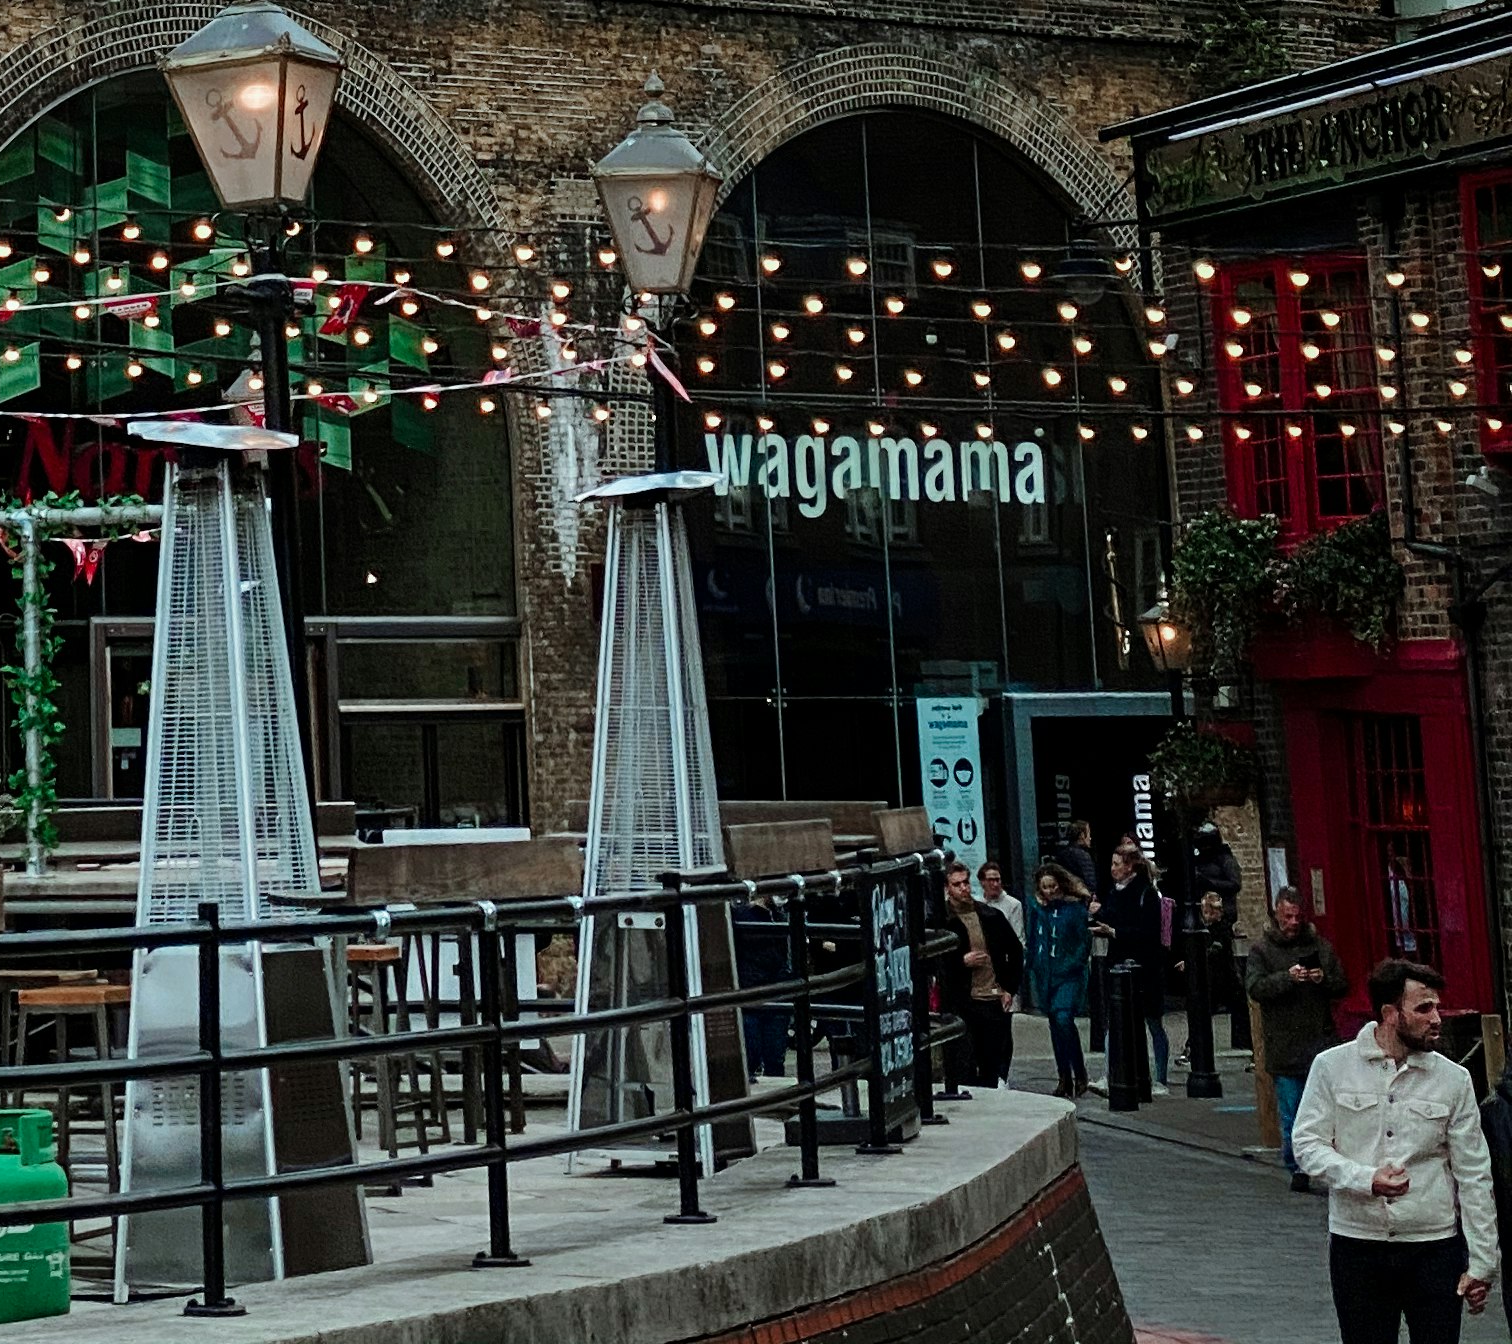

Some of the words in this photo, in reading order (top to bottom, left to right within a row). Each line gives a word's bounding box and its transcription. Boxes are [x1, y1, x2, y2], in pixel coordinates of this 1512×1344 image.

[1244, 122, 1304, 186] THE
[1313, 88, 1450, 166] ANCHOR
[705, 432, 1046, 518] wagamama
